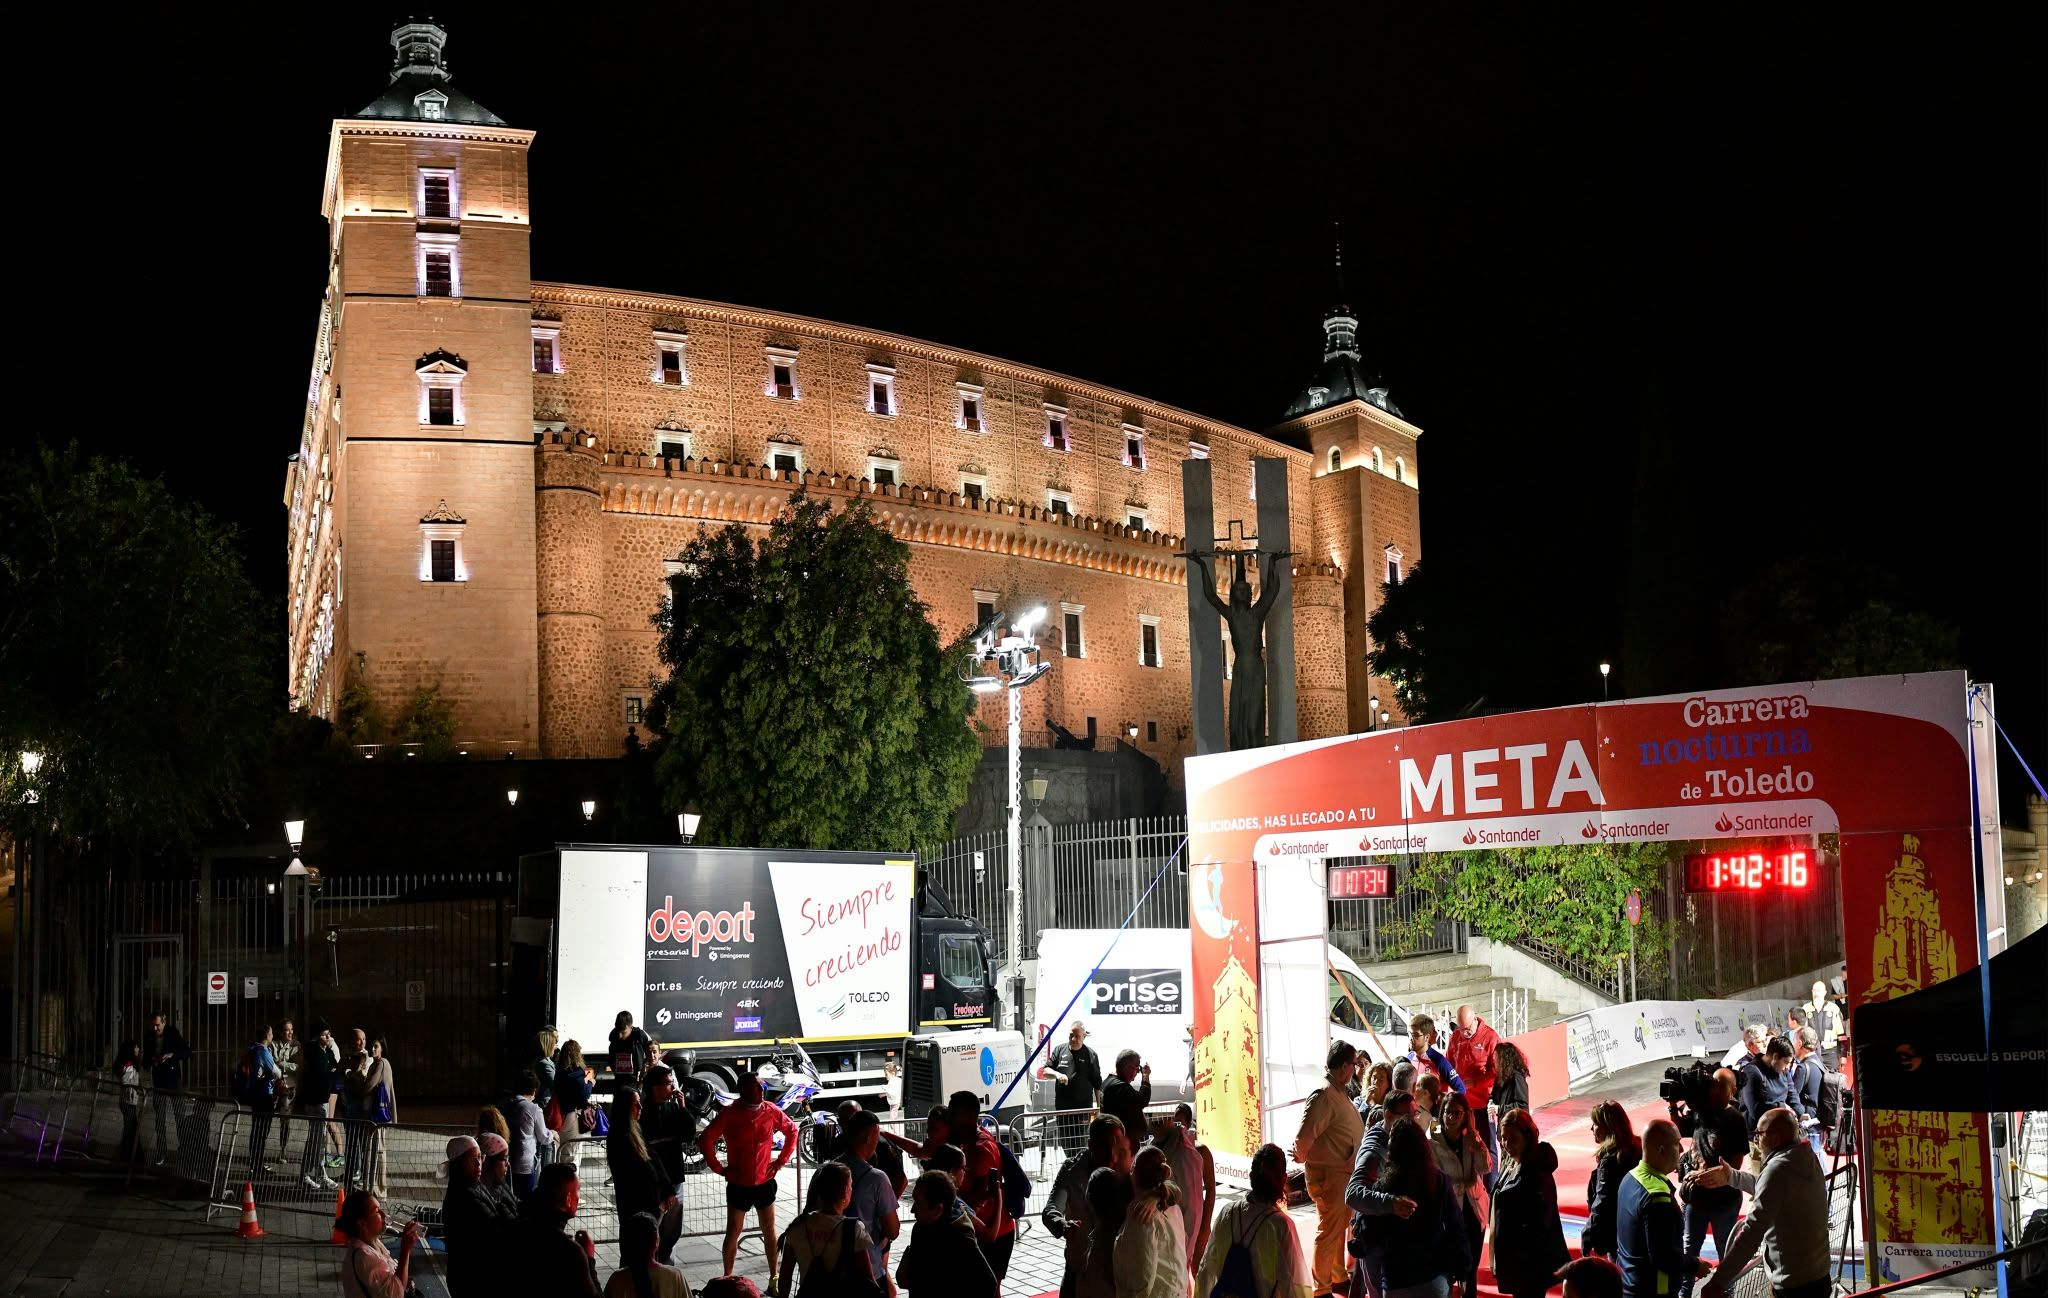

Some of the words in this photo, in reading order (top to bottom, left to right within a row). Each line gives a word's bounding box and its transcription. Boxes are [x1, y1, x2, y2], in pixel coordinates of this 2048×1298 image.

[1683, 696, 1810, 728] Carrera
[1638, 726, 1813, 767] nocturna
[1399, 739, 1608, 820] META
[1680, 783, 1703, 800] de
[1705, 765, 1815, 798] Toledo
[1196, 816, 1262, 834] ELICIDADES,
[1264, 814, 1287, 828] HAS
[1289, 810, 1345, 827] LLEGADO
[1347, 809, 1358, 822] A
[1359, 807, 1376, 821] TU
[1600, 821, 1671, 838] Santander
[1735, 813, 1814, 832] Santander
[1372, 835, 1428, 851] Santander
[1478, 827, 1541, 844] Santander
[1281, 842, 1329, 855] Santander
[1709, 851, 1809, 889] 1:42:16
[801, 880, 896, 936] Siempre
[647, 895, 756, 958] deport
[647, 948, 690, 958] presarial
[719, 952, 751, 960] timingsense
[806, 926, 902, 987] creciendo
[695, 975, 738, 997] Siempre
[742, 976, 785, 990] creciendo
[1090, 975, 1179, 1009] prise
[848, 991, 890, 1004] TOLEDO
[674, 1010, 723, 1021] timingsense
[1108, 1002, 1179, 1013] rent-a-car
[941, 1043, 977, 1055] GENERAC
[2002, 1049, 2048, 1062] DEPOR
[1214, 1162, 1250, 1180] Santand
[1884, 1245, 1934, 1257] Carrera
[1935, 1246, 1994, 1258] nocturna
